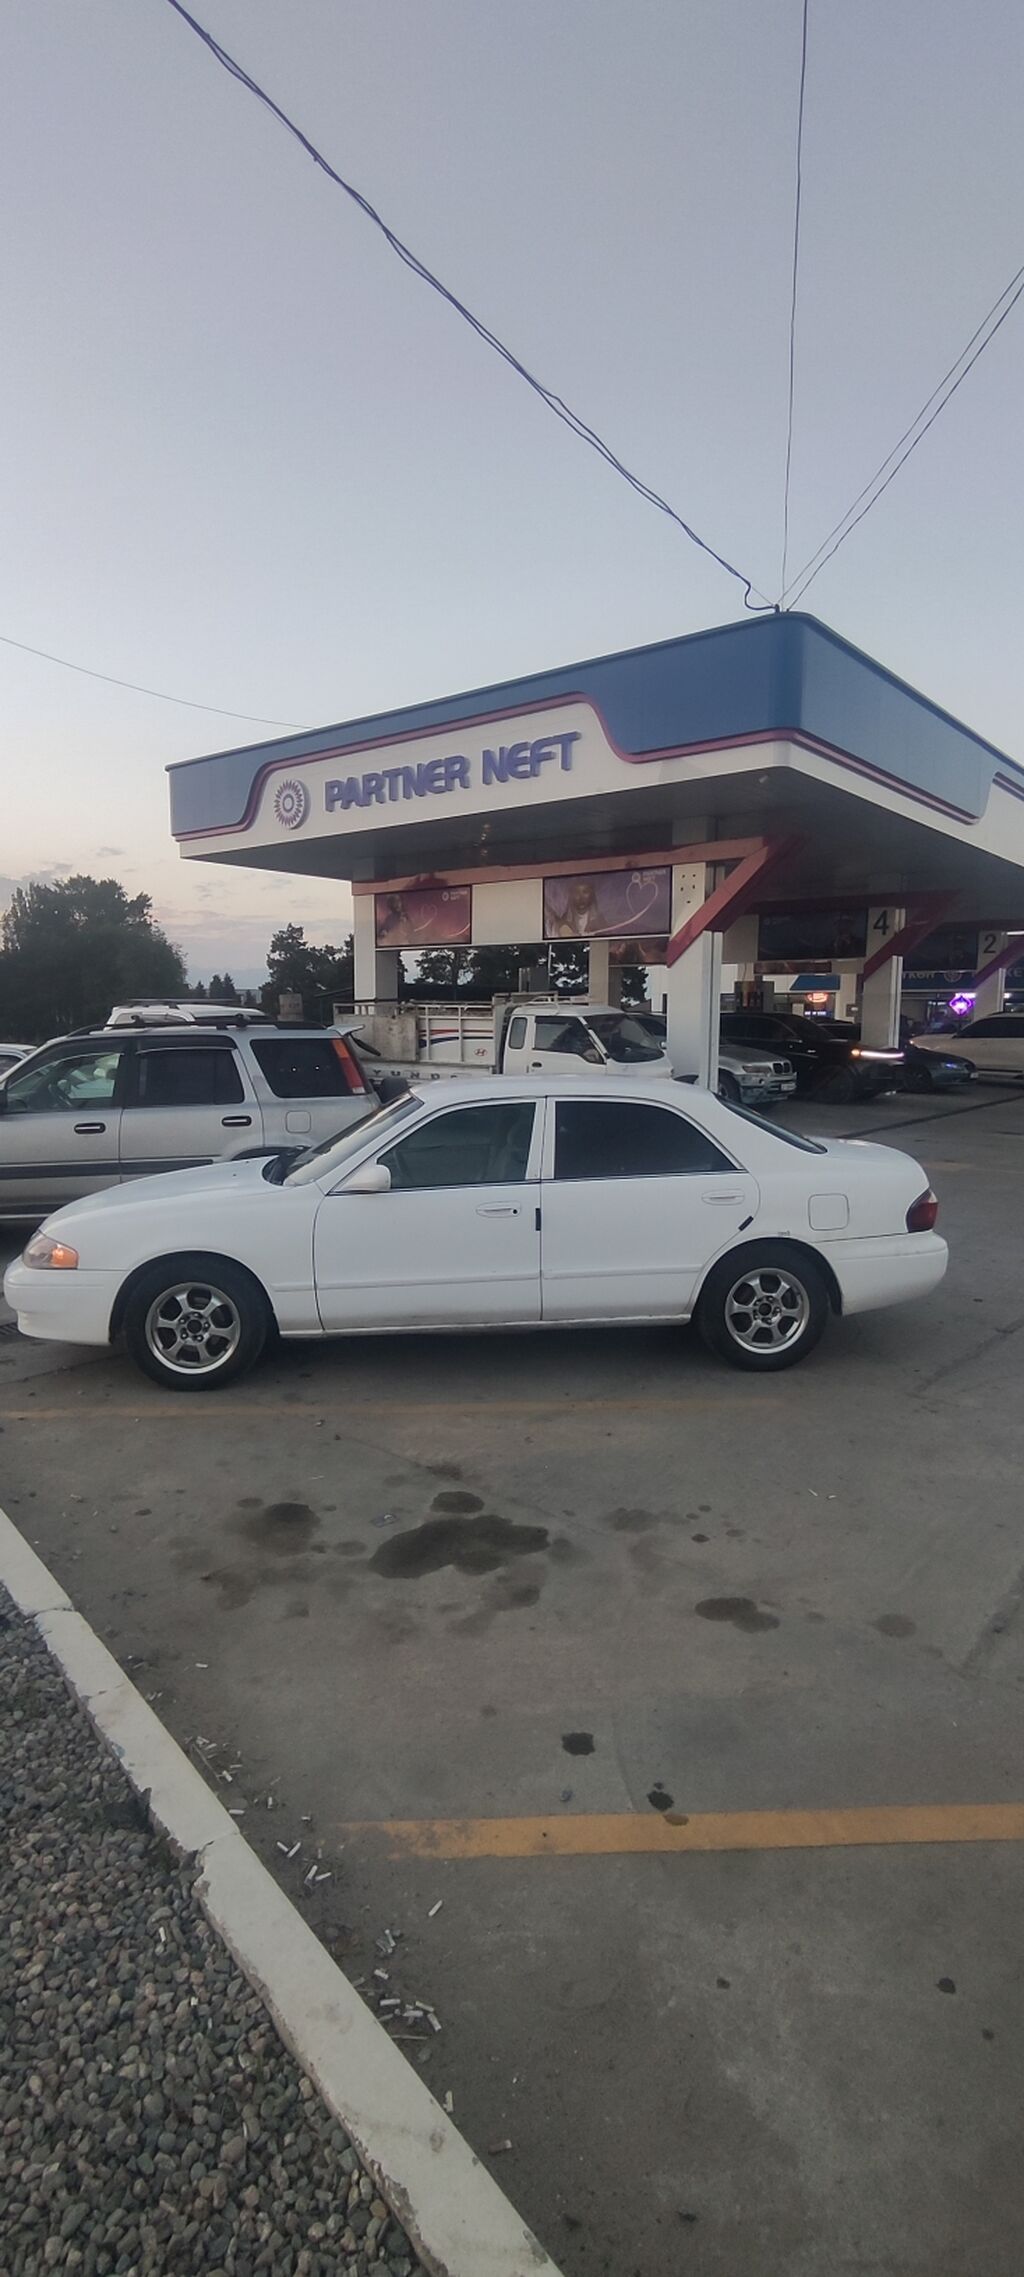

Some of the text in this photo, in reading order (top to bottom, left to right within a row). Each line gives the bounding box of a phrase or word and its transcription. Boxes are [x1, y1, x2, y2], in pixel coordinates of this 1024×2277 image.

[325, 731, 581, 813] PARTNER NEFT
[873, 909, 889, 935] 4
[983, 933, 997, 954] 2
